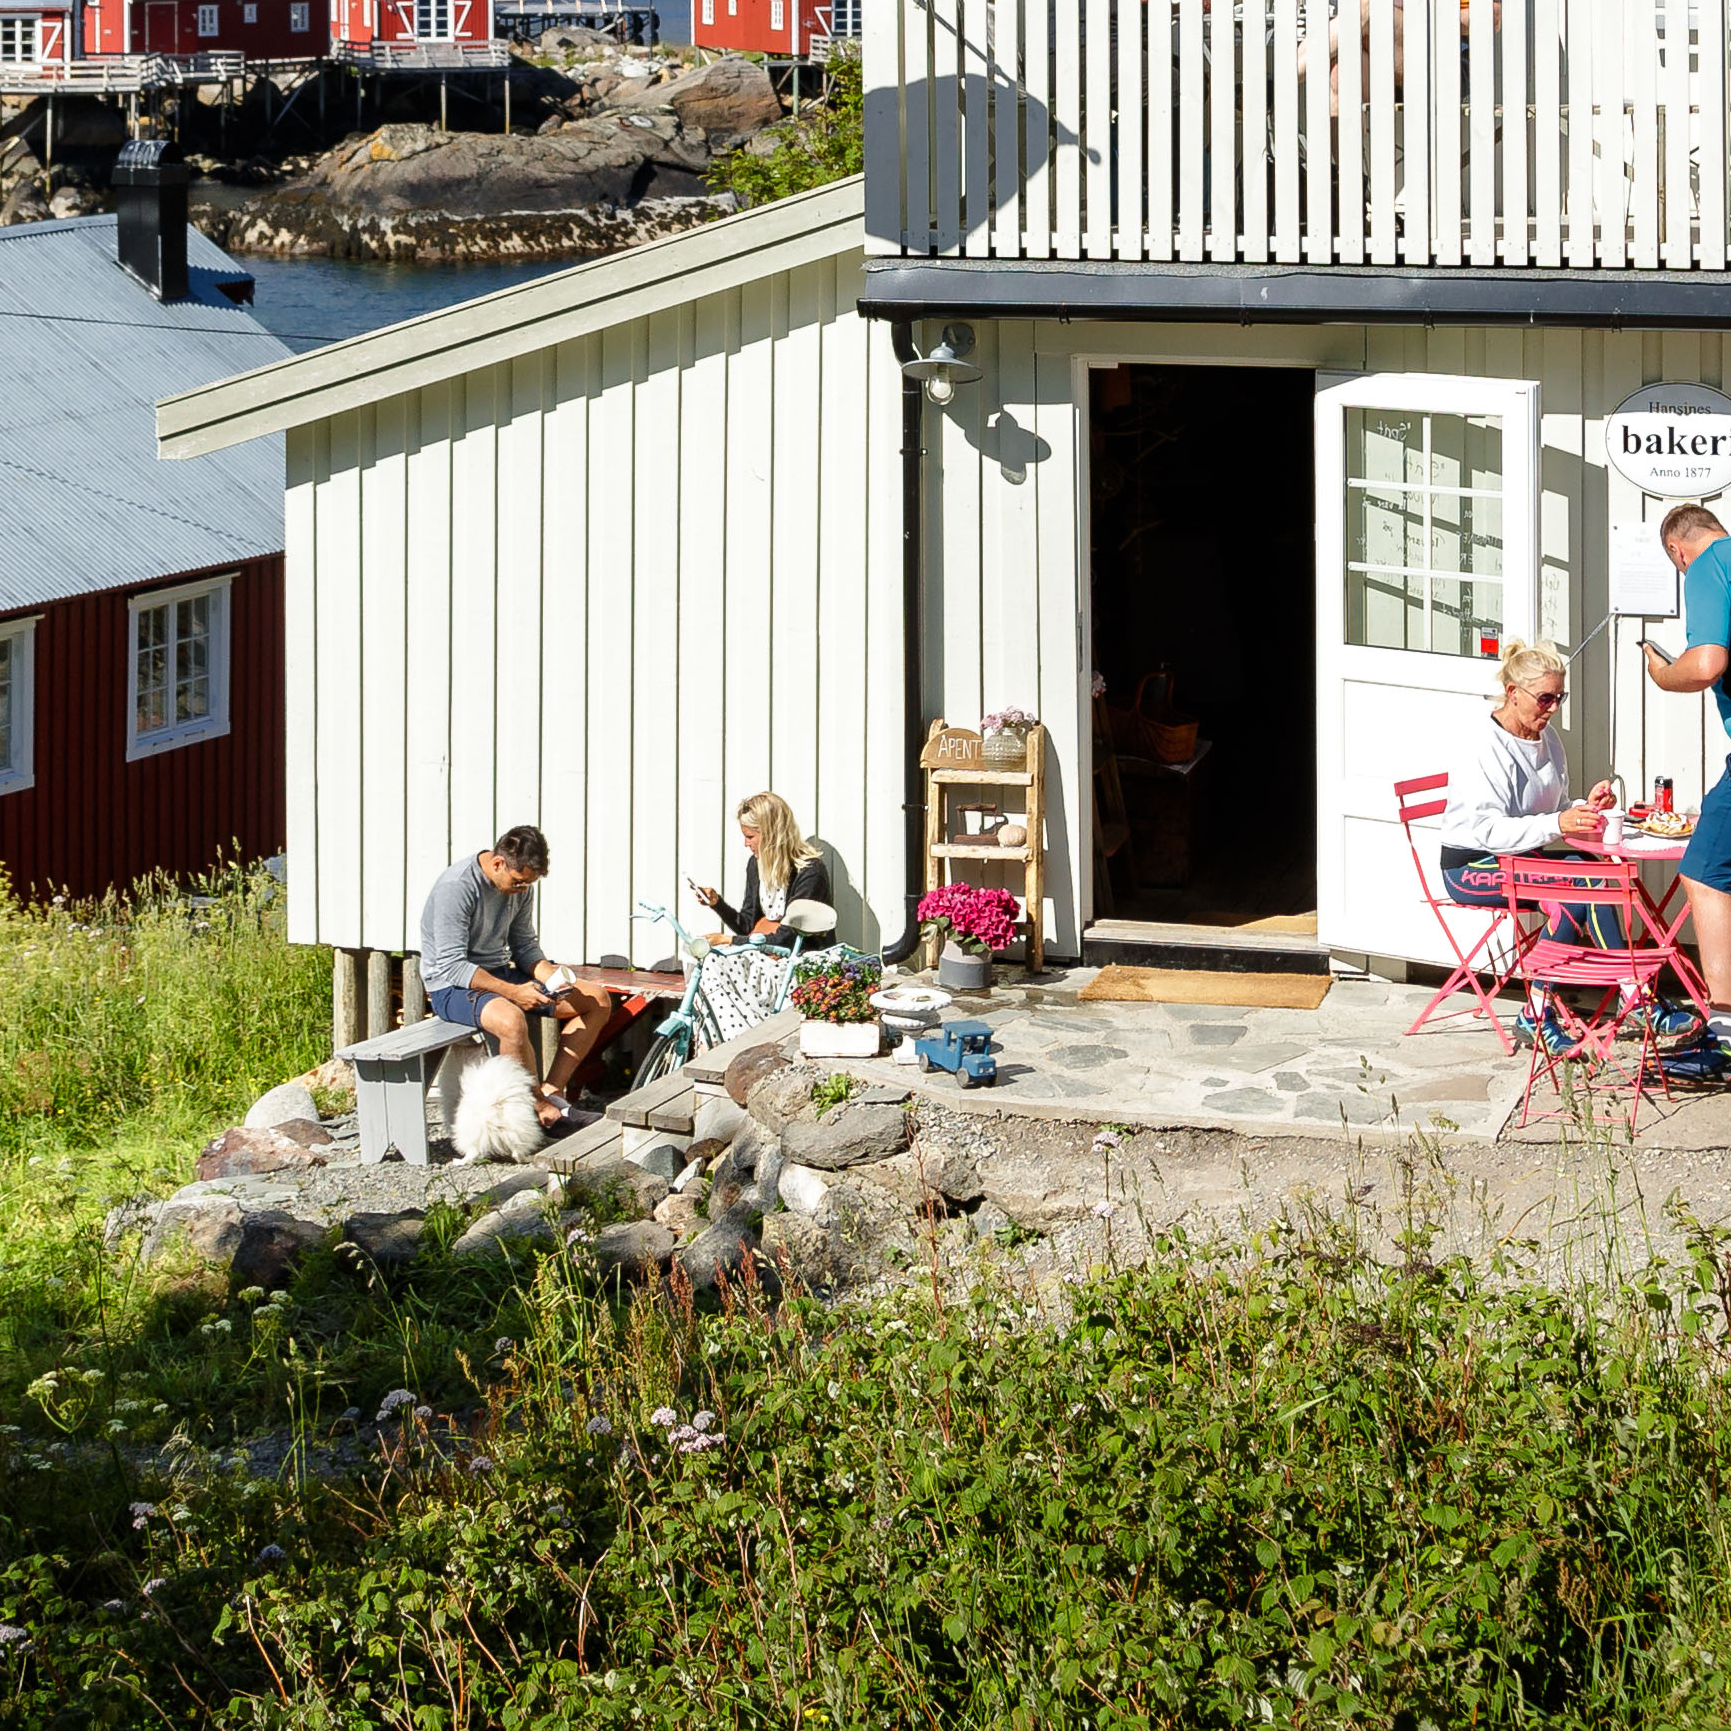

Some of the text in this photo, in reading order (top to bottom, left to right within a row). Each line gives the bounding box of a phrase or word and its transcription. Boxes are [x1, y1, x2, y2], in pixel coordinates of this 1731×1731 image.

[1649, 401, 1711, 415] Hansines
[1649, 467, 1711, 478] Anno 1877
[937, 734, 982, 760] ÅPENT
[1461, 869, 1513, 887] KAR
